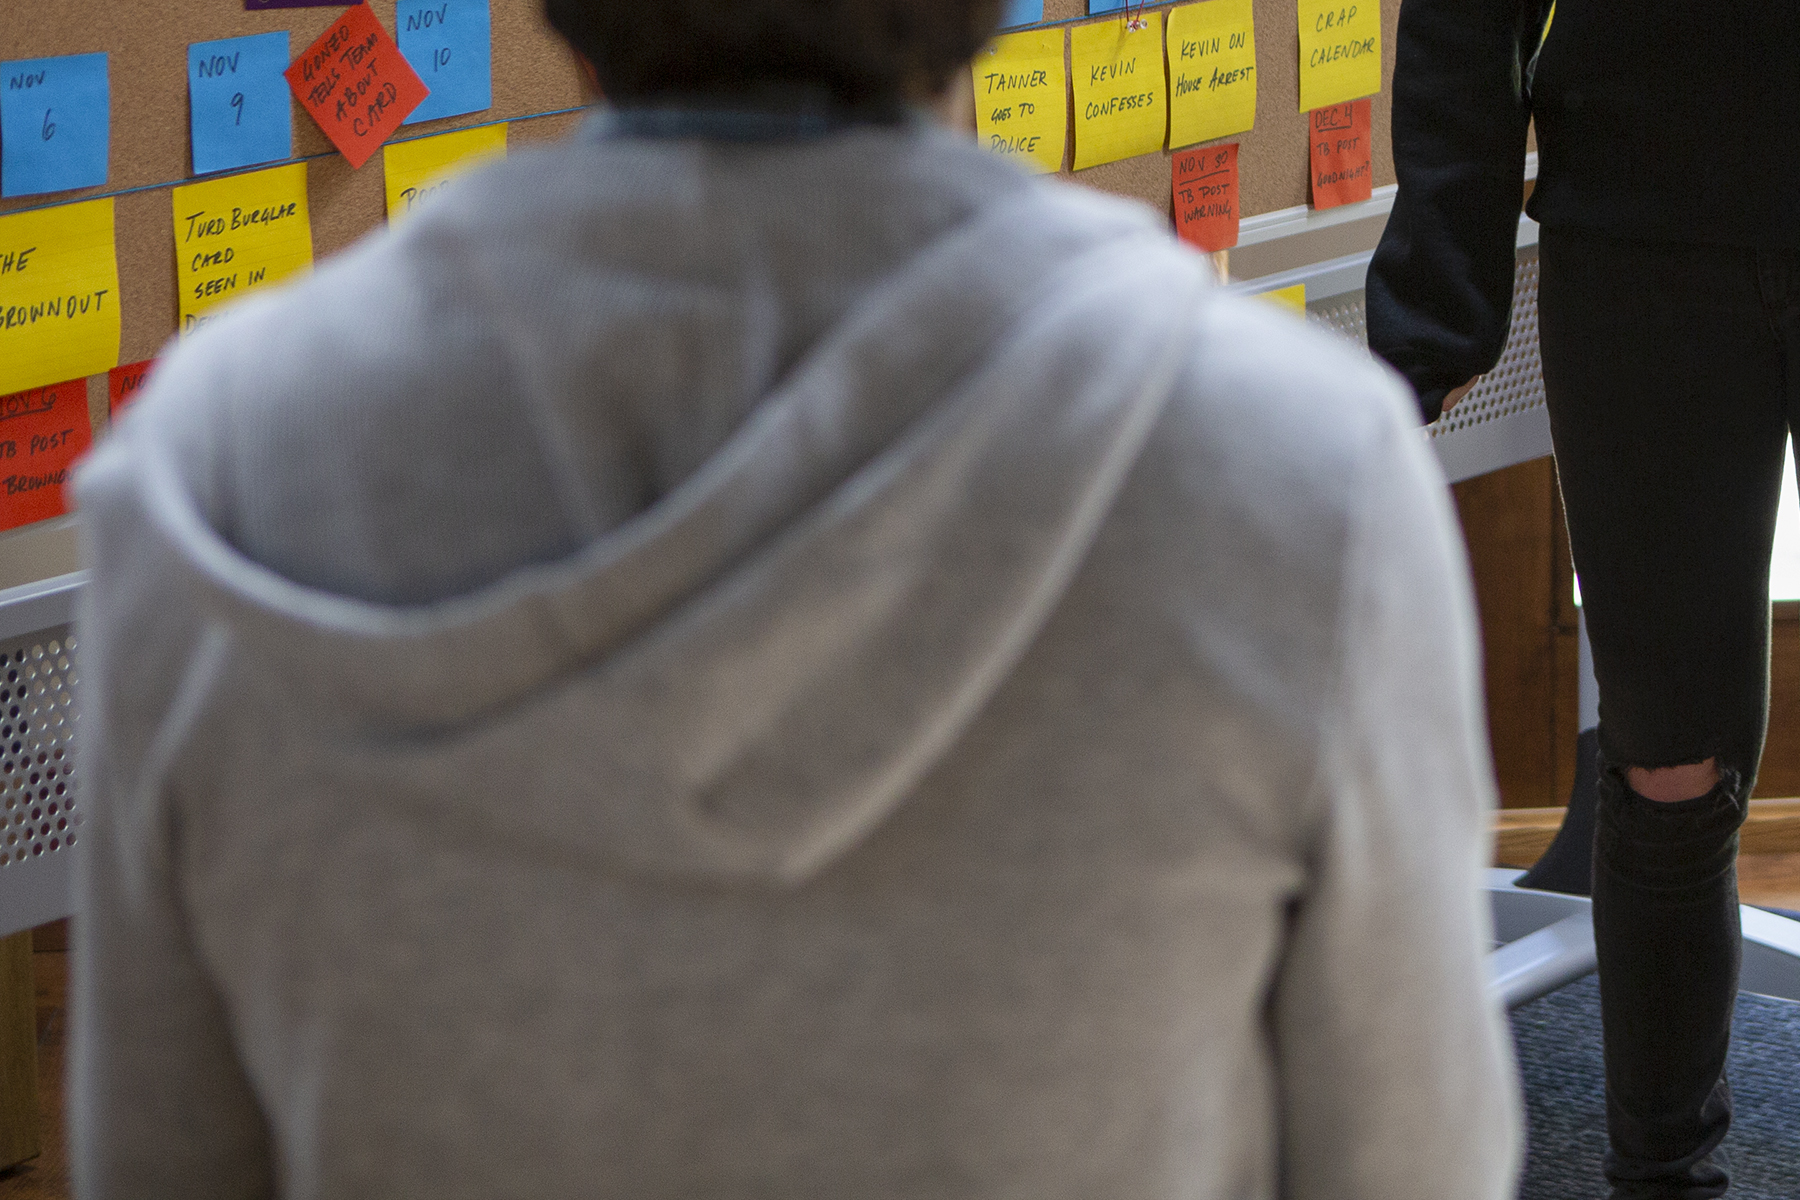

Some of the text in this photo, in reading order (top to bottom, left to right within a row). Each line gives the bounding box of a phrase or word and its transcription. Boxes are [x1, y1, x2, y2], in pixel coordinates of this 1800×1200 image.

[407, 4, 447, 32] NOV
[1316, 6, 1358, 33] CRAP
[1180, 32, 1246, 61] KEVIN ON
[1310, 37, 1375, 68] CALENDAR
[199, 52, 240, 78] NOV
[434, 48, 450, 72] 10
[1090, 58, 1136, 86] KEVIN
[10, 70, 45, 90] NOV
[336, 58, 378, 122] ABOUT
[985, 70, 1047, 94] TANNER
[1208, 66, 1254, 92] ARREST
[231, 92, 244, 126] 9
[354, 82, 397, 136] CARD
[991, 102, 1035, 125] GOES TO
[1085, 92, 1154, 120] CONFESSES
[1314, 106, 1339, 129] DEC
[42, 108, 56, 141] 6
[991, 135, 1040, 154] POLICE
[1316, 138, 1360, 156] TB POST
[1179, 155, 1206, 175] NOV
[1178, 184, 1230, 204] TB POST
[231, 202, 297, 231] BURGLAR
[1183, 204, 1232, 226] WARNING
[192, 247, 234, 272] CARD
[194, 266, 266, 299] SEEN IN
[120, 373, 147, 394] NO
[30, 428, 74, 456] POST
